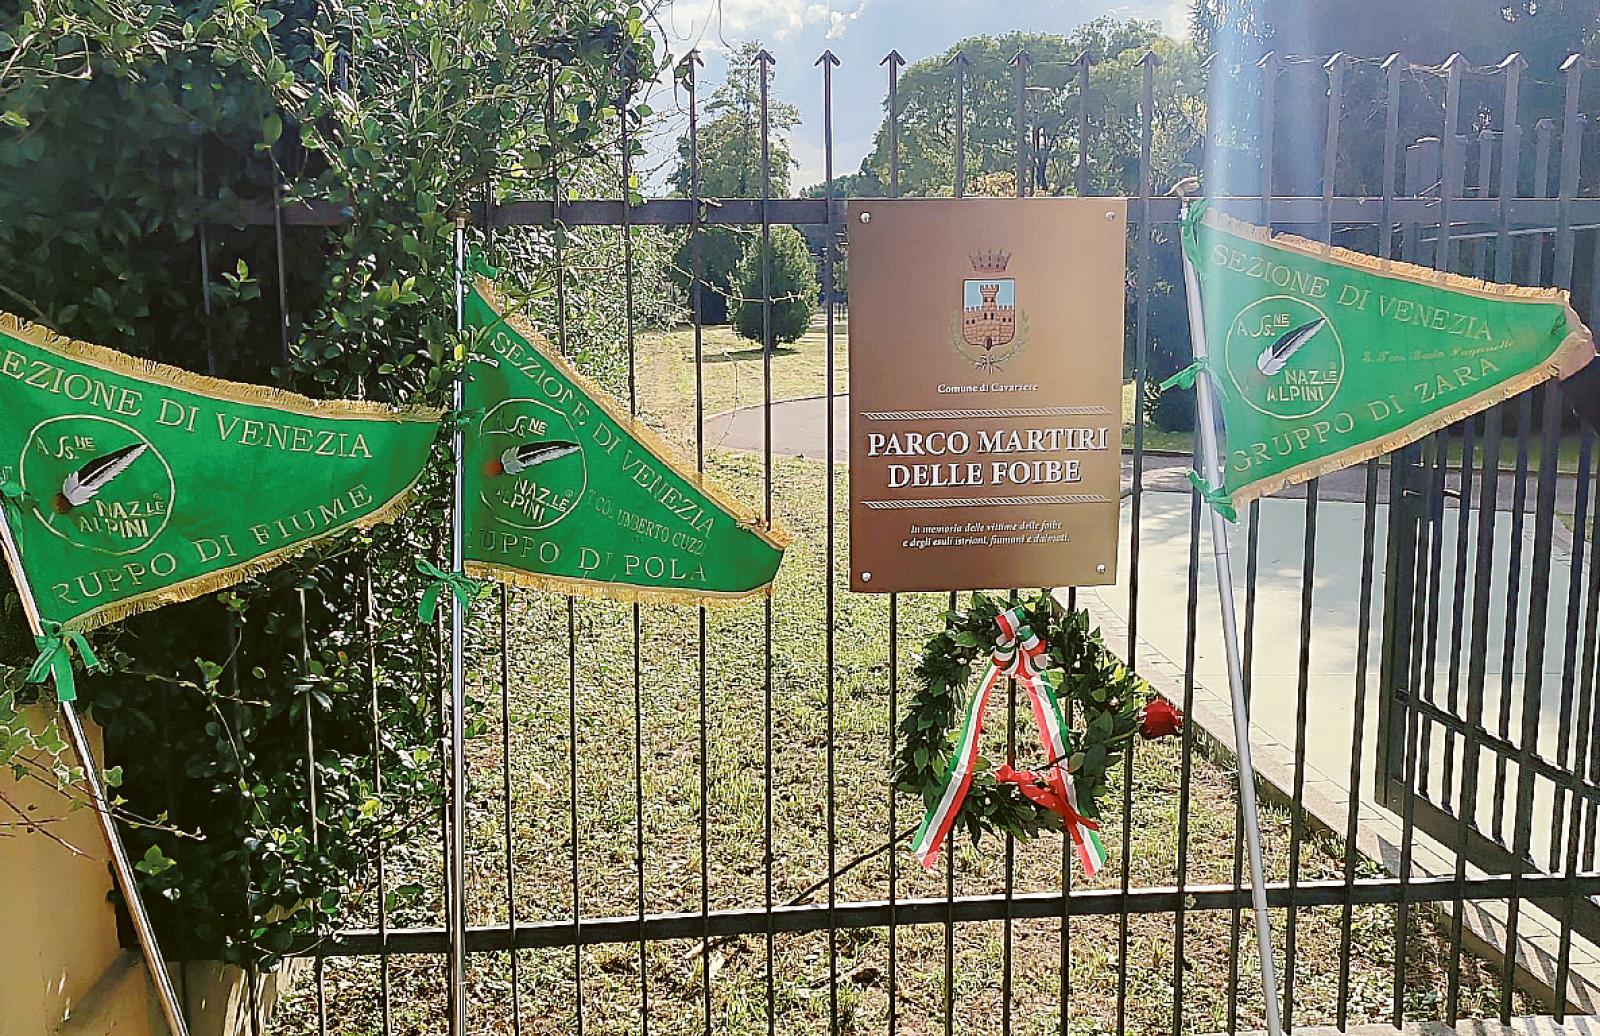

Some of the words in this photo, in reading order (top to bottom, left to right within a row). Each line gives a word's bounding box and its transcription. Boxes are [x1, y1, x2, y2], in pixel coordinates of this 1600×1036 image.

[1211, 243, 1330, 299] SEZIONE
[1337, 283, 1371, 311] DI
[1380, 294, 1493, 341] VENEZIA
[937, 383, 978, 394] Comune
[979, 382, 990, 393] di
[1266, 385, 1324, 401] ALPINI
[1367, 394, 1405, 421] DI
[1414, 358, 1501, 404] ZARA
[0, 350, 143, 417] EZIONE
[156, 398, 200, 433] DI
[215, 412, 373, 460] VENEZIA
[867, 431, 970, 457] PARCO
[976, 427, 1109, 454] MARTIRI
[592, 423, 622, 456] DI
[622, 448, 714, 540] VENEZIA
[887, 463, 985, 489] DELLE
[990, 459, 1082, 486] FOIBE
[80, 516, 149, 539] ALPINI
[910, 525, 921, 534] In
[922, 523, 962, 534] memoria
[964, 522, 985, 534] delle
[987, 520, 1018, 532] vittime
[1019, 520, 1040, 531] delle
[51, 552, 176, 605] RUPPO
[194, 533, 240, 564] DI
[249, 483, 374, 546] FIUME
[463, 528, 560, 564] UPPO
[624, 554, 708, 582] POLA
[672, 532, 705, 557] CUZZ
[909, 537, 931, 550] degli
